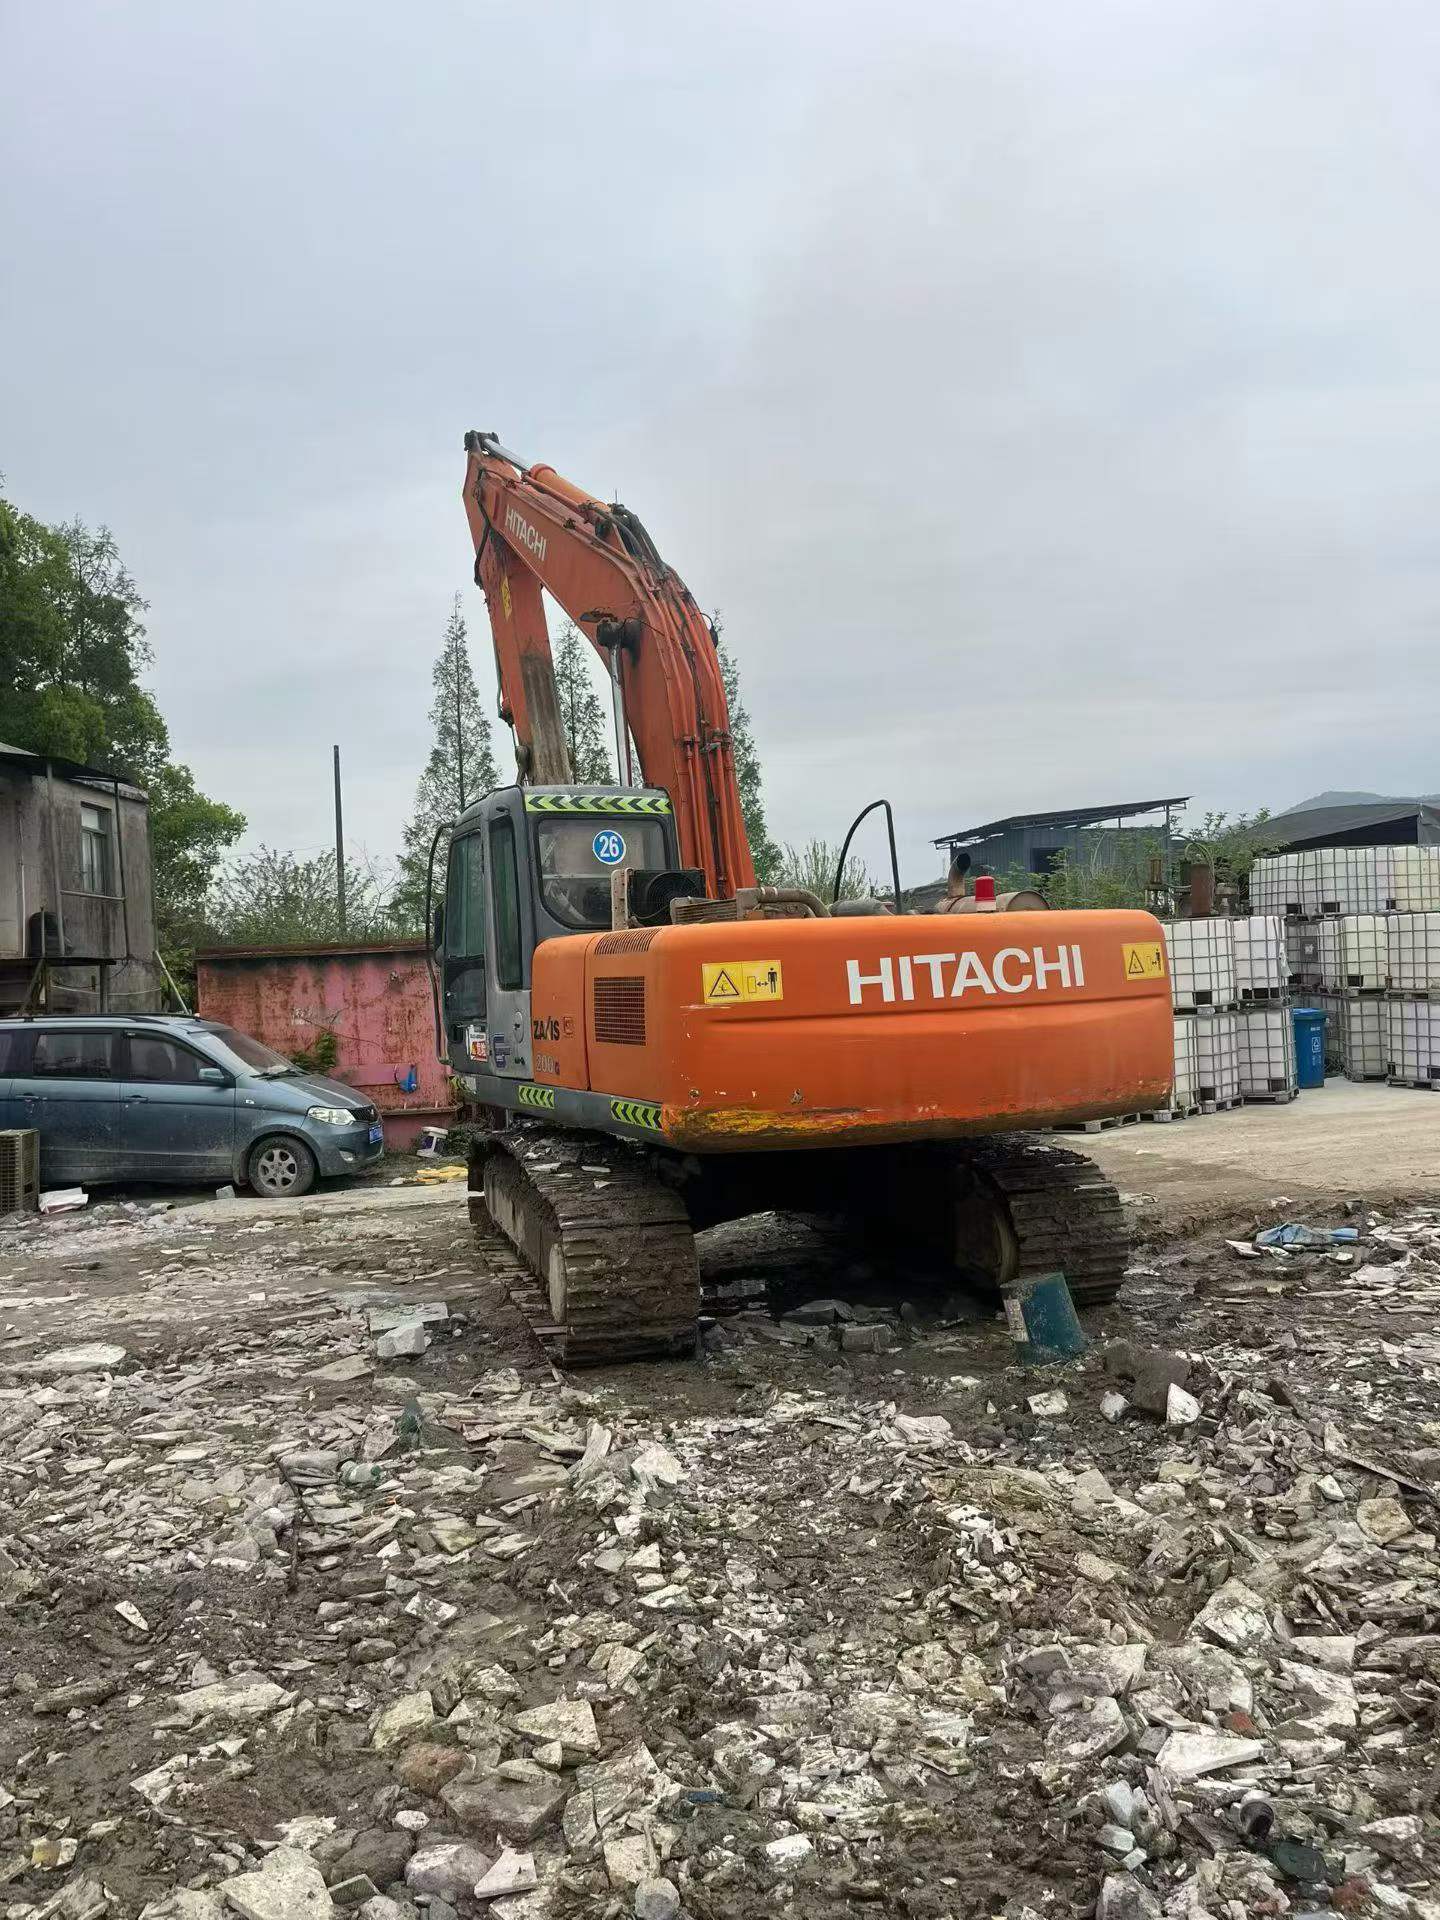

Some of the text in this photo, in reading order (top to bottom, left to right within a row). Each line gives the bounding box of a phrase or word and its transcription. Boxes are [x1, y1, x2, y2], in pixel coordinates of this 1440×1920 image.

[505, 504, 547, 561] HITACHI
[599, 836, 620, 857] 26
[846, 945, 1085, 1005] HITACHI
